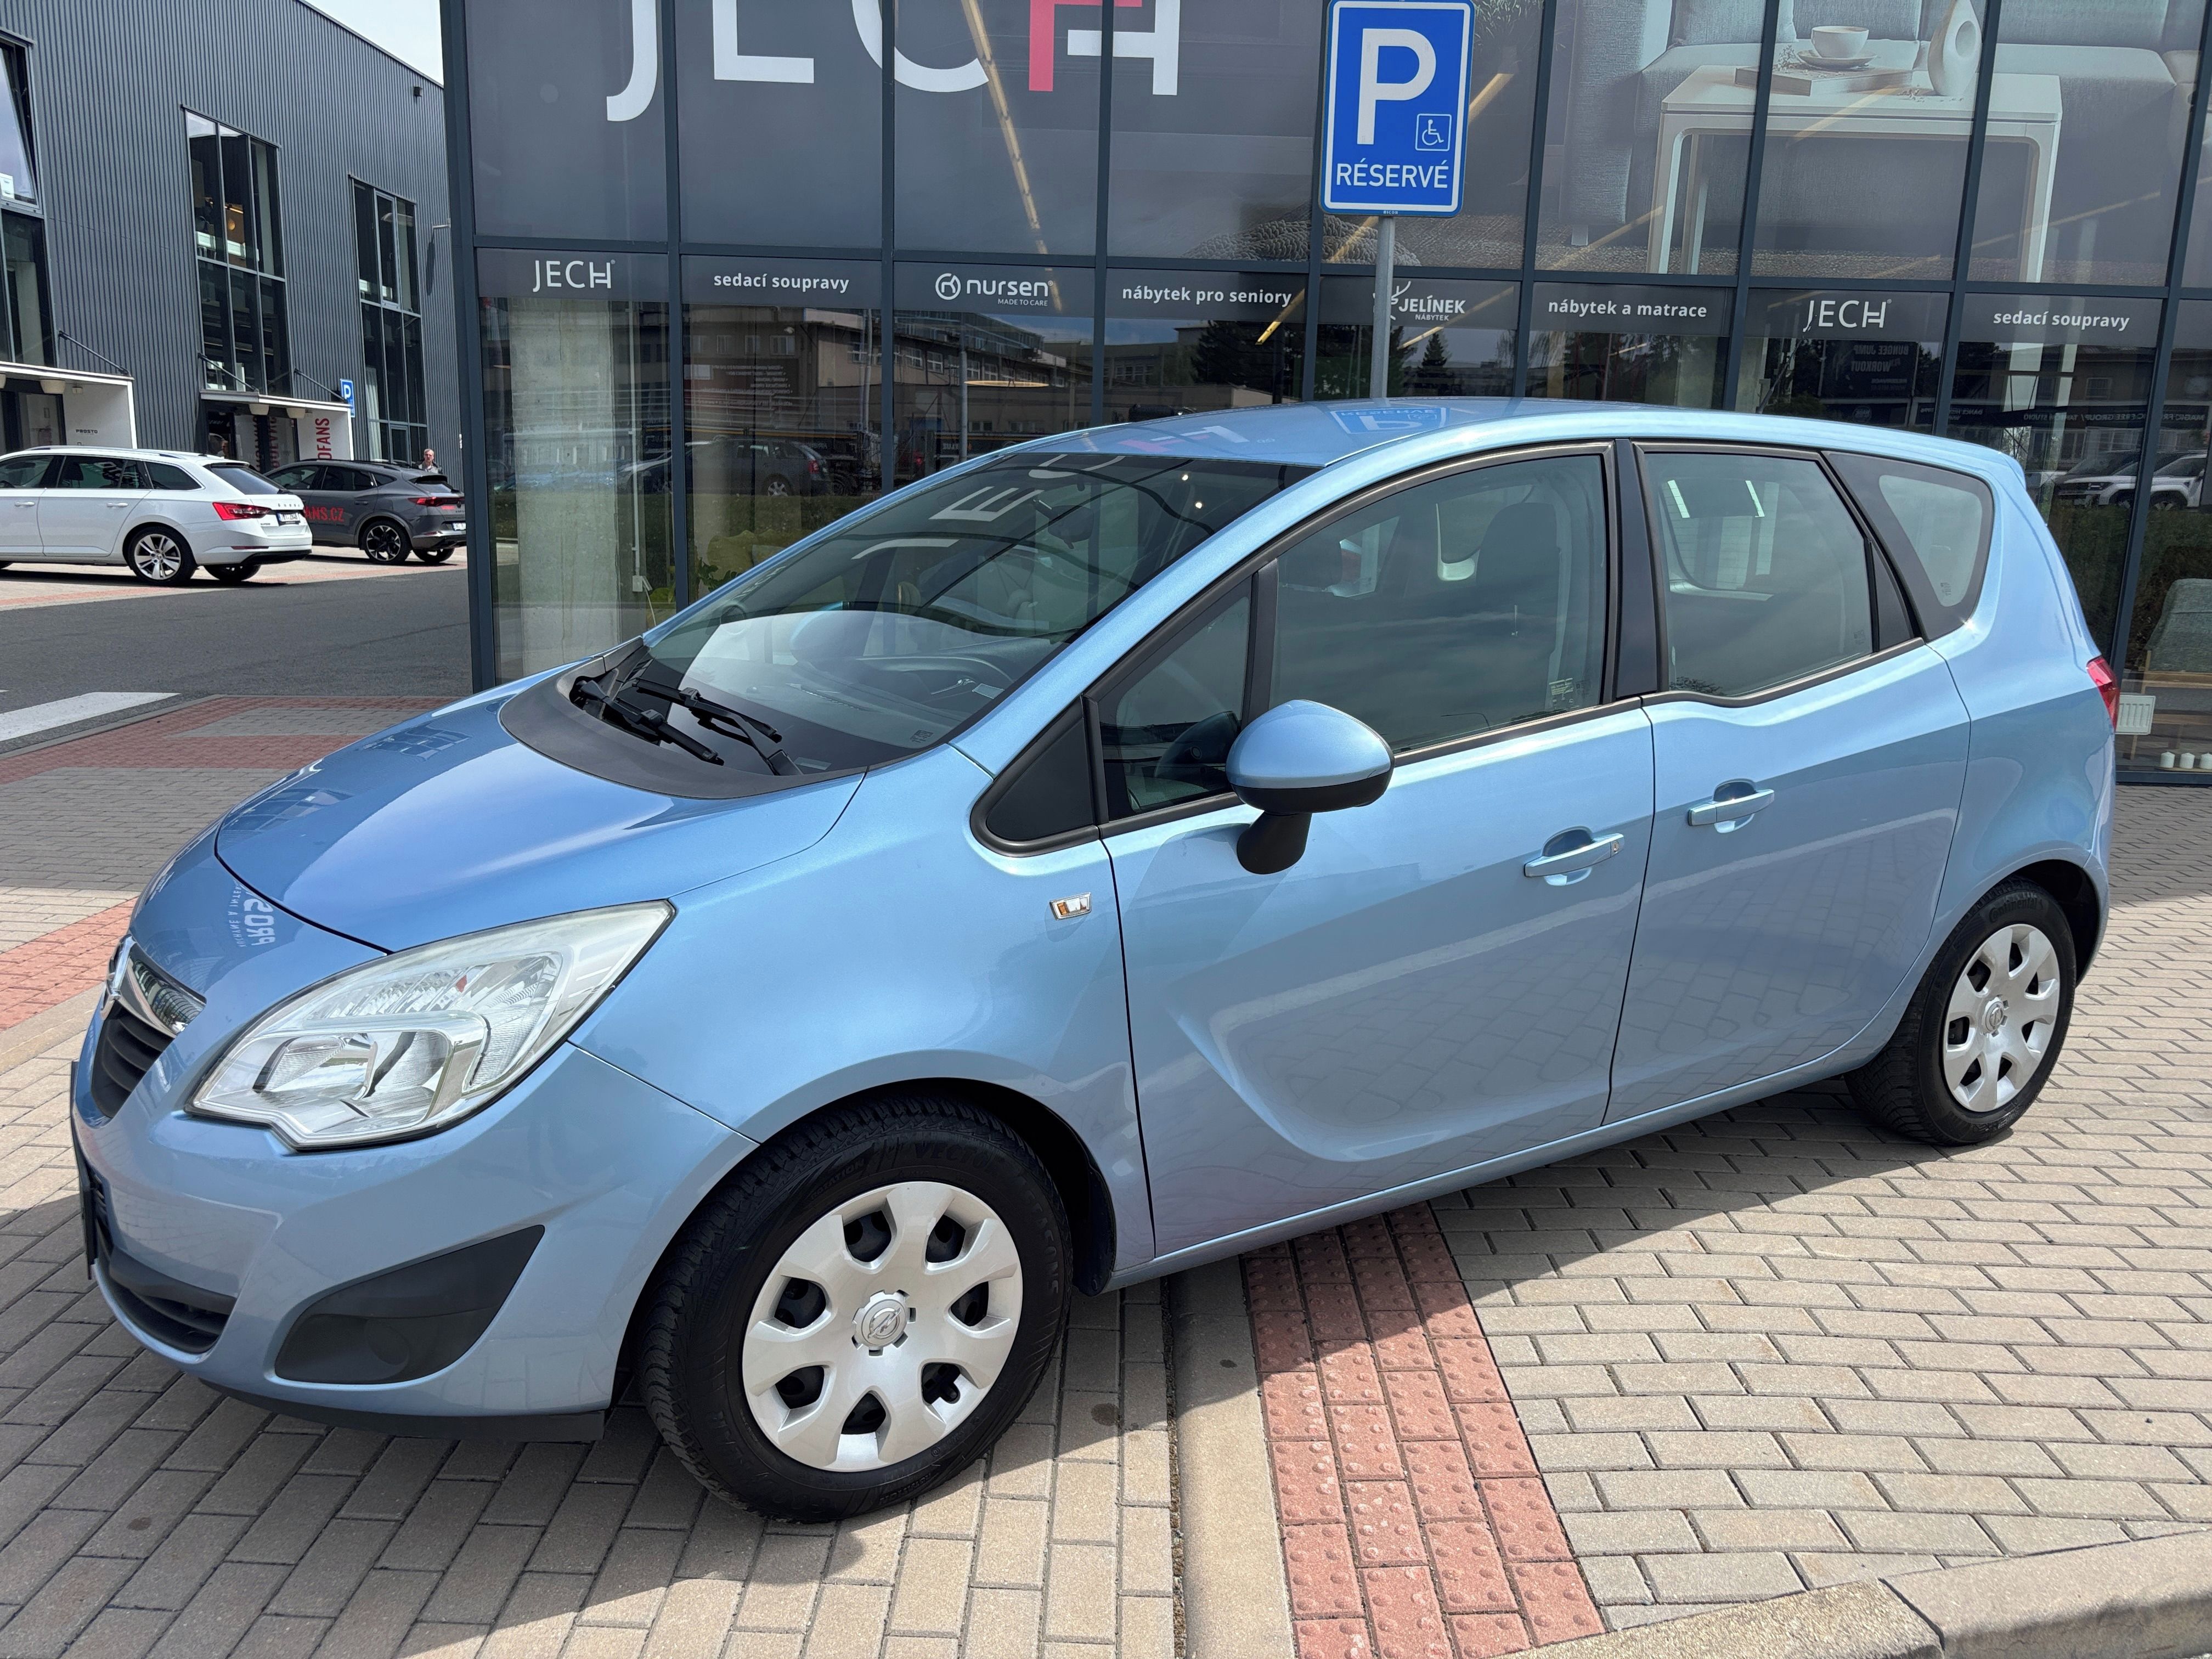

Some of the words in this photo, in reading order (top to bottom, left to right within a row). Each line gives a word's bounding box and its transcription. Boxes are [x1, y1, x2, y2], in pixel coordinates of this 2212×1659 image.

[1357, 29, 1437, 145] P
[1337, 158, 1449, 188] RÉSERVÉ
[533, 260, 612, 292] JECH
[714, 273, 768, 287] sedací
[772, 277, 849, 294] soupravy
[967, 280, 1049, 297] nursen
[1122, 286, 1190, 304] nábytek
[1196, 291, 1224, 305] pro
[1229, 290, 1291, 307] seniory
[1399, 295, 1466, 314] JELÍNEK
[1548, 299, 1617, 317] nábytek
[1622, 304, 1631, 315] a
[1637, 304, 1707, 318] matrace
[1415, 313, 1449, 321] NÁBYTEK
[1803, 300, 1886, 332] JECH
[1993, 310, 2049, 325] sedací
[2052, 315, 2130, 331] soupravy
[343, 384, 352, 400] P
[304, 506, 345, 521] ANS.CZ
